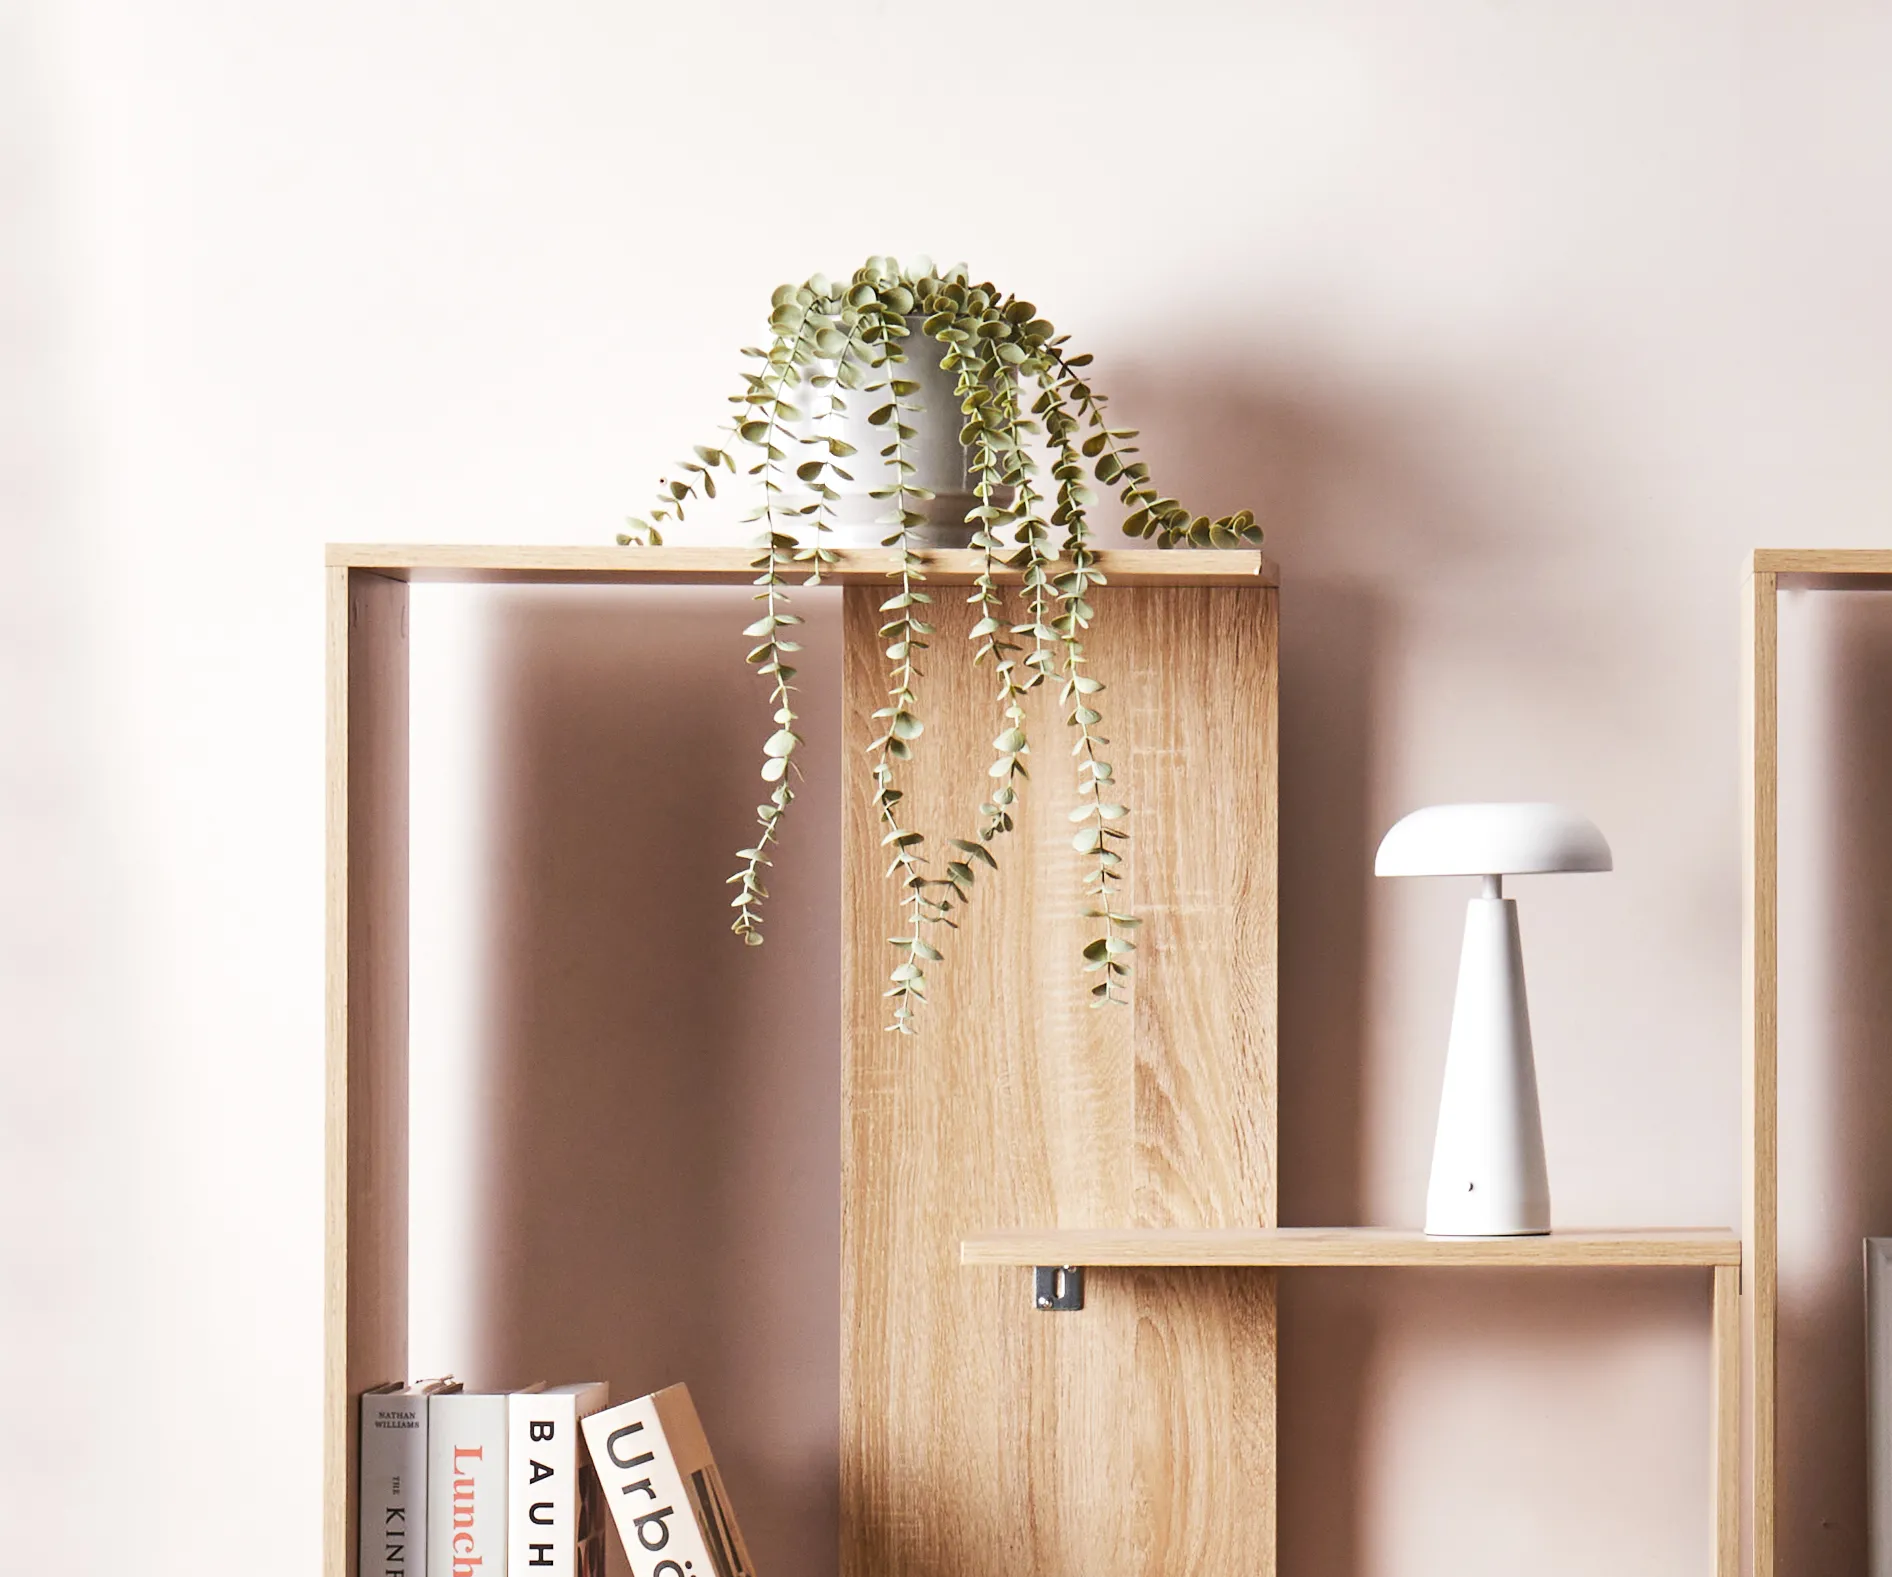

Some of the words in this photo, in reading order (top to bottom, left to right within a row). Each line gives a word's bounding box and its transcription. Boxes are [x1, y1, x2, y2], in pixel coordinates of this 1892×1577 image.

[378, 1411, 416, 1419] NATHAN
[375, 1421, 420, 1429] WILLIAMS
[391, 1476, 400, 1495] THE
